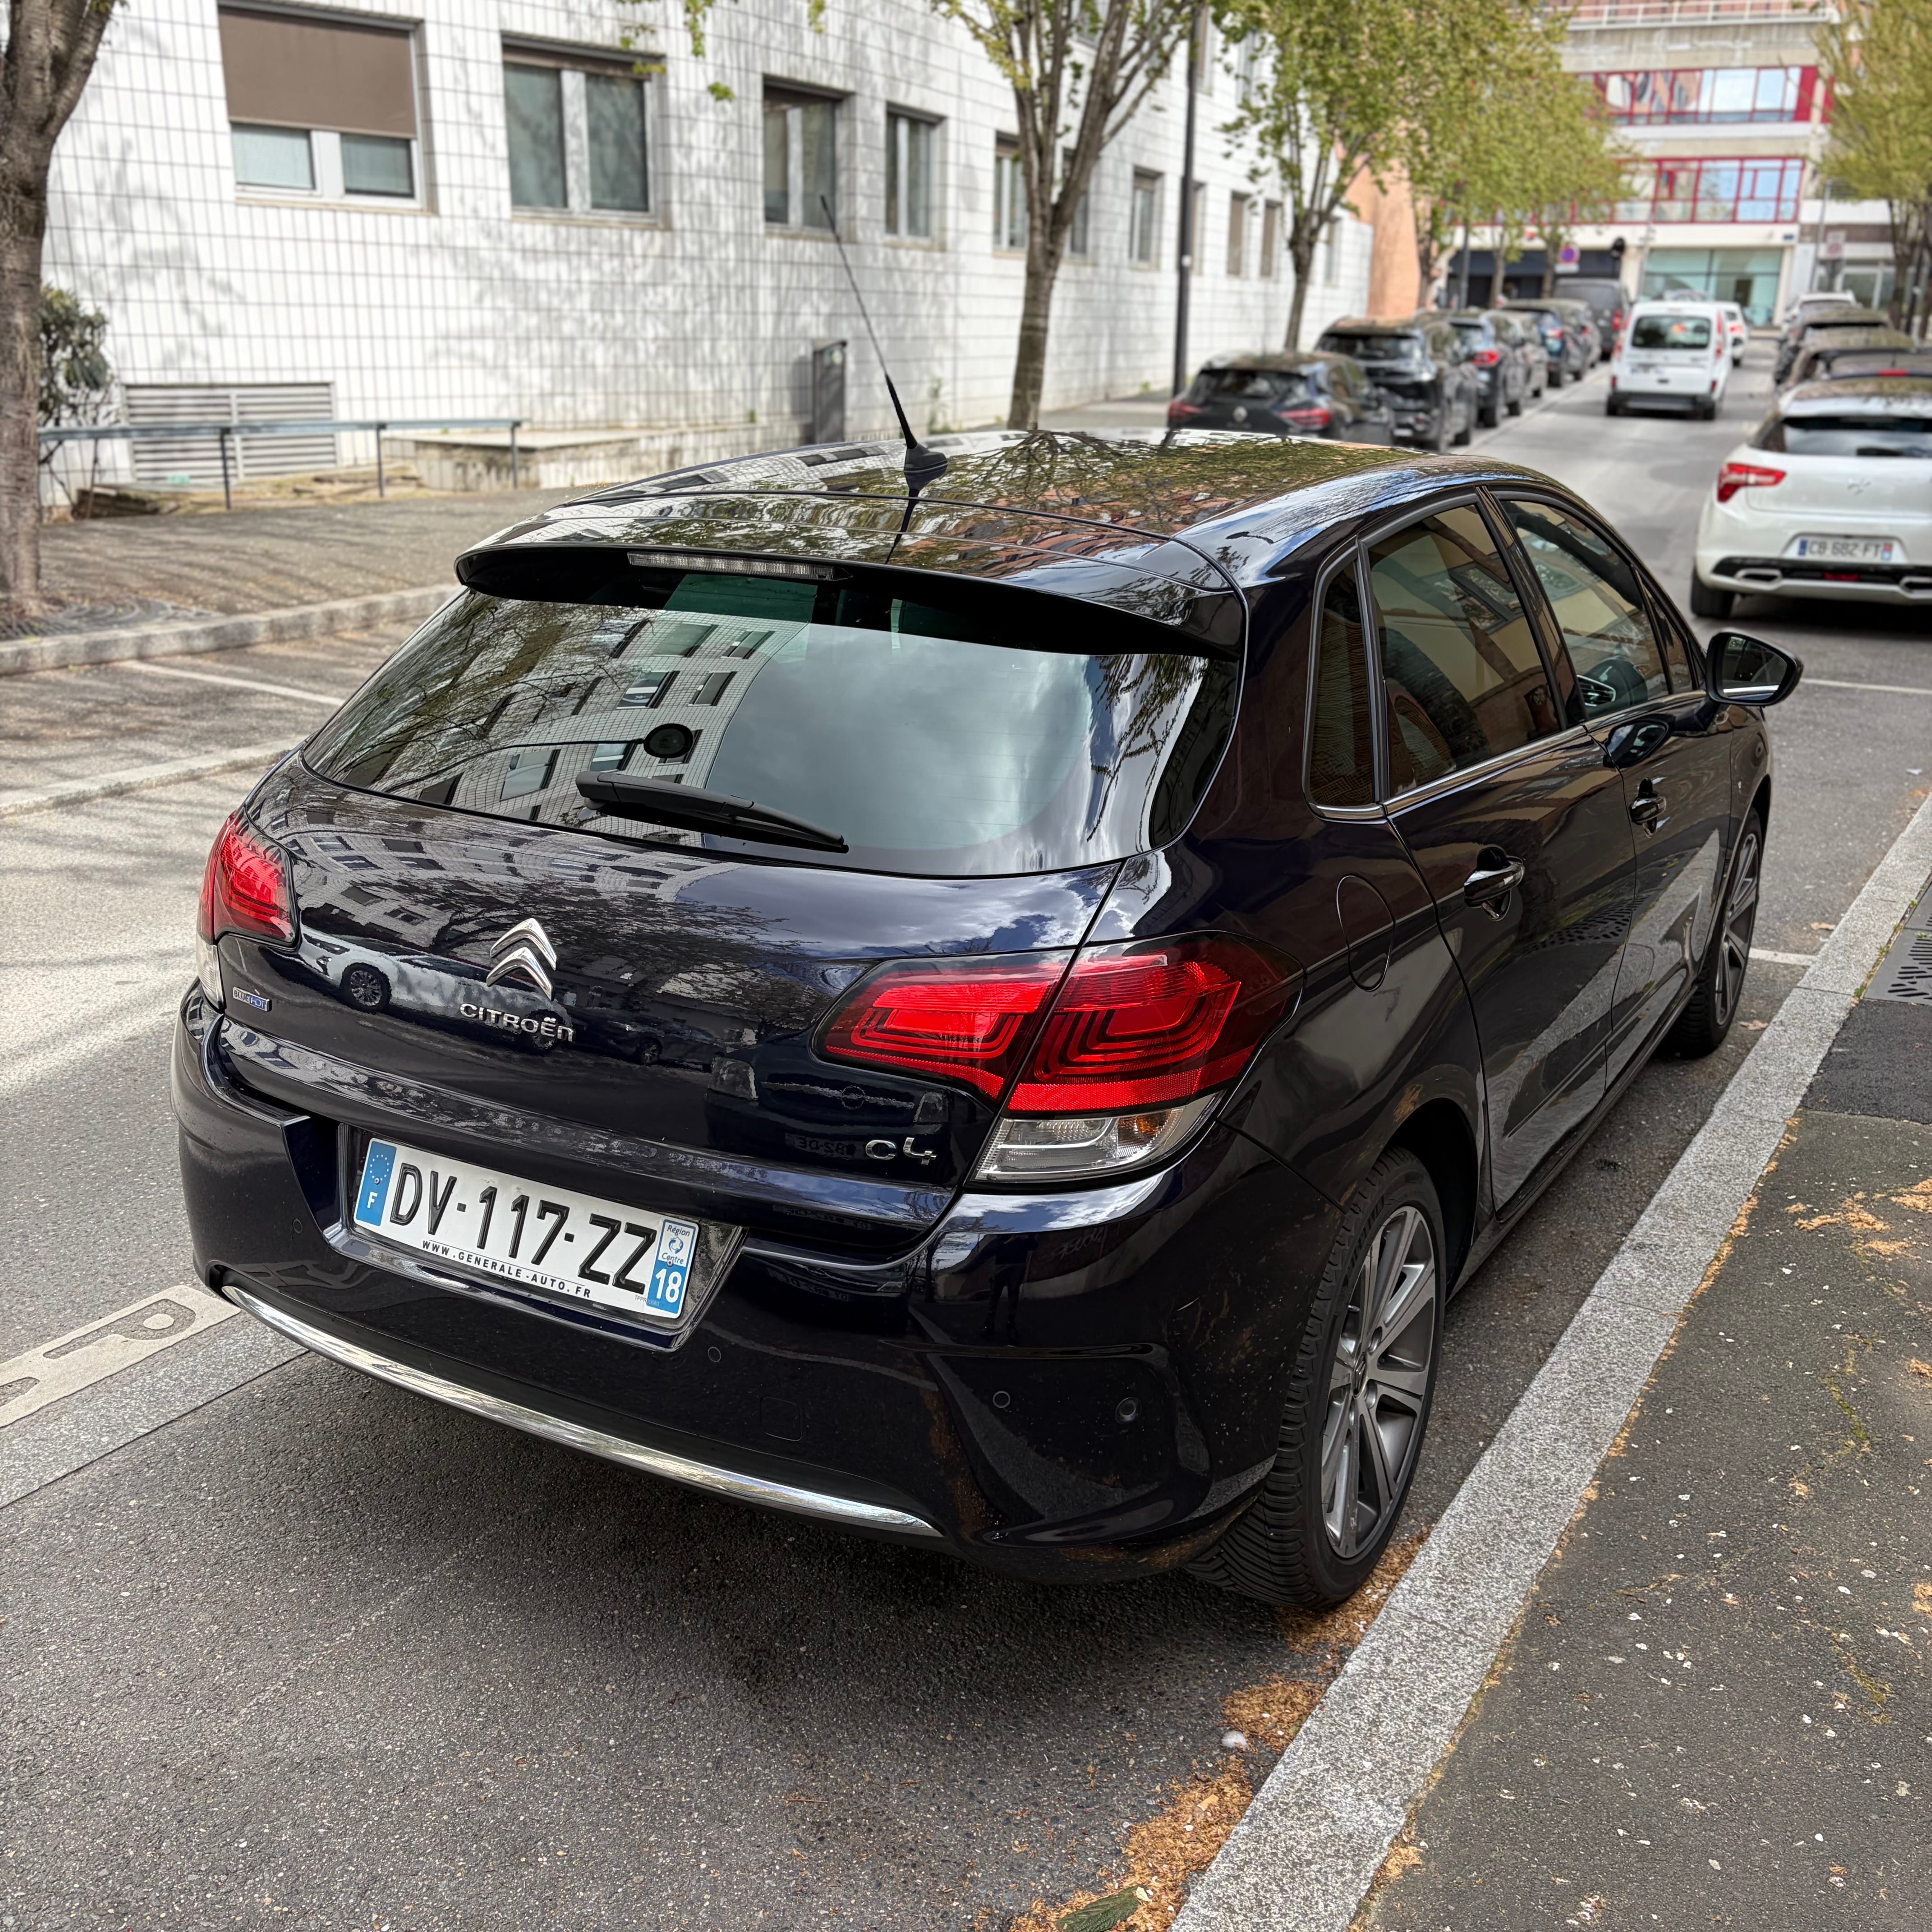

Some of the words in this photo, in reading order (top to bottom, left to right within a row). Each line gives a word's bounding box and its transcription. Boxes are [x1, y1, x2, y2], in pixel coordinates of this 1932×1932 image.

[865, 1136, 938, 1165] C4
[367, 1192, 378, 1209] F
[390, 1162, 658, 1294] DV-117-ZZ
[667, 1224, 690, 1237] Région
[661, 1252, 684, 1265] Centre
[655, 1268, 682, 1303] 18
